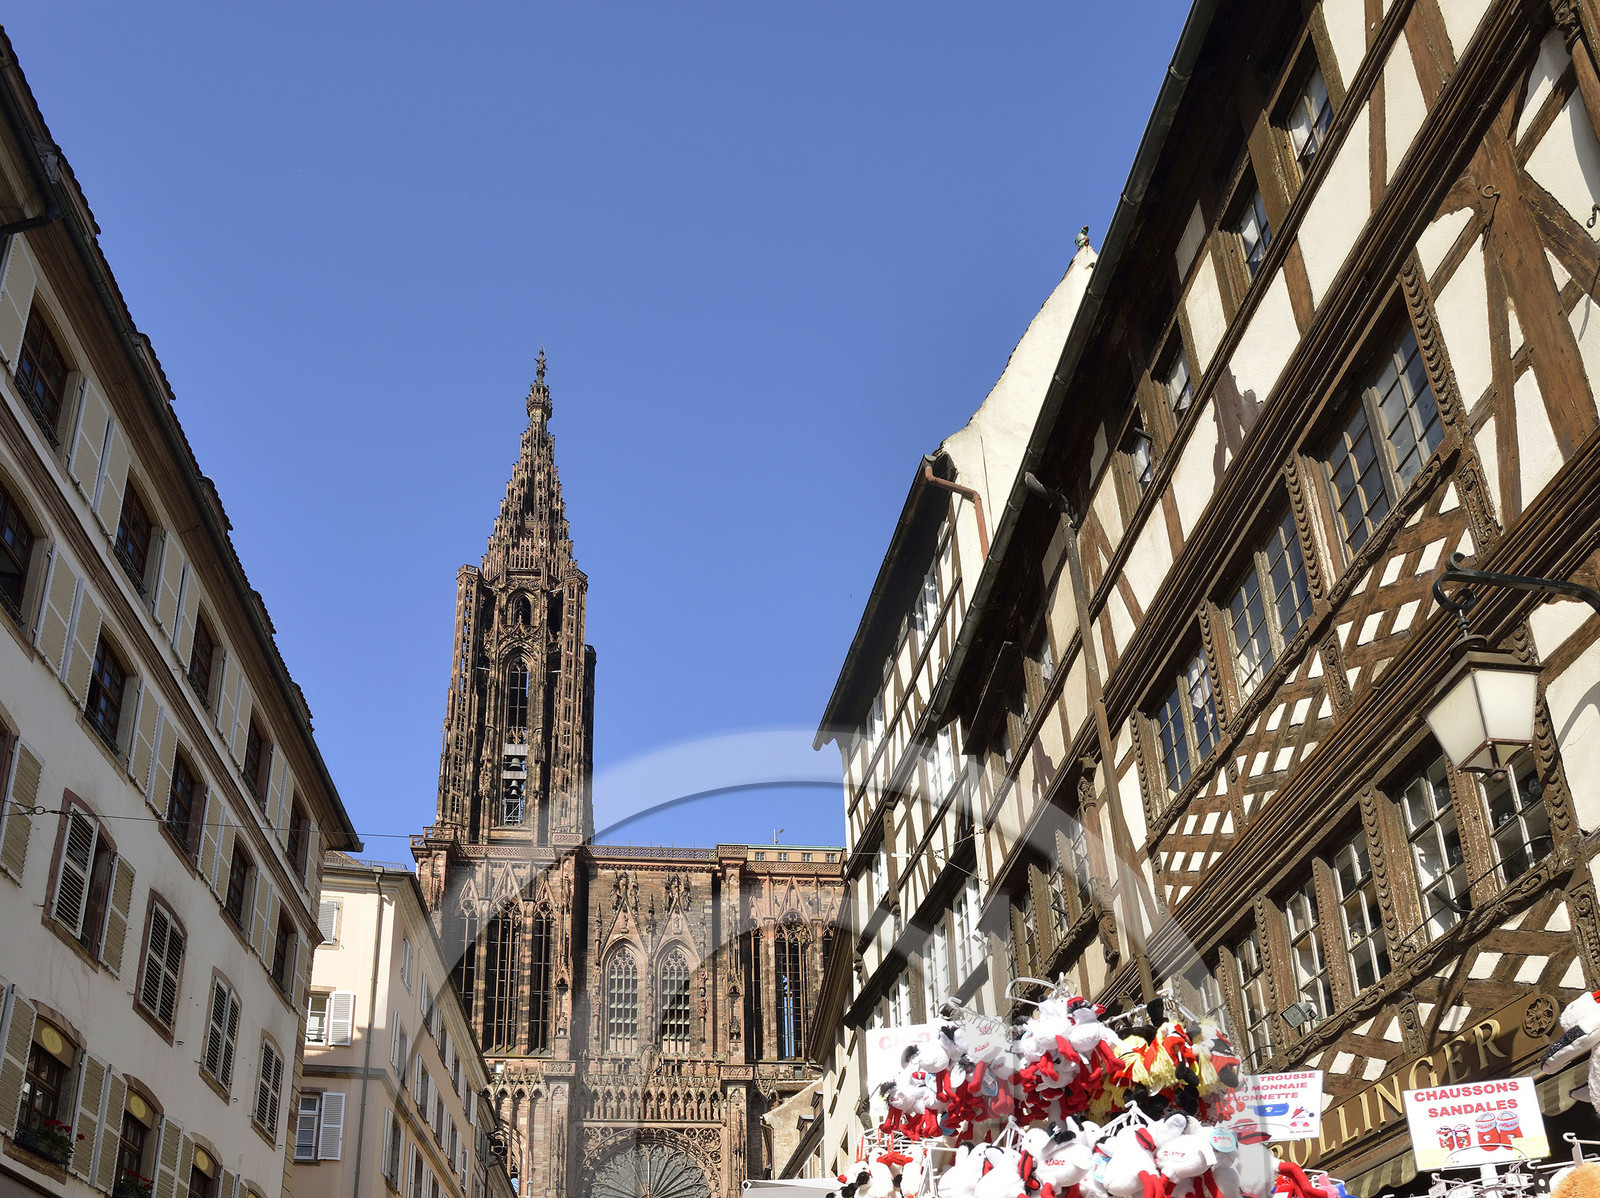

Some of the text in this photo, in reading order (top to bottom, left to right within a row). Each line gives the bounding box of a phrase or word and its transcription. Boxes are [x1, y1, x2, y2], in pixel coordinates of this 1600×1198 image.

[1259, 1072, 1316, 1082] TROUSSE
[1251, 1081, 1308, 1092] MONNAIE
[1413, 1080, 1520, 1103] CHAUSSONS
[1427, 1098, 1519, 1119] SANDALES
